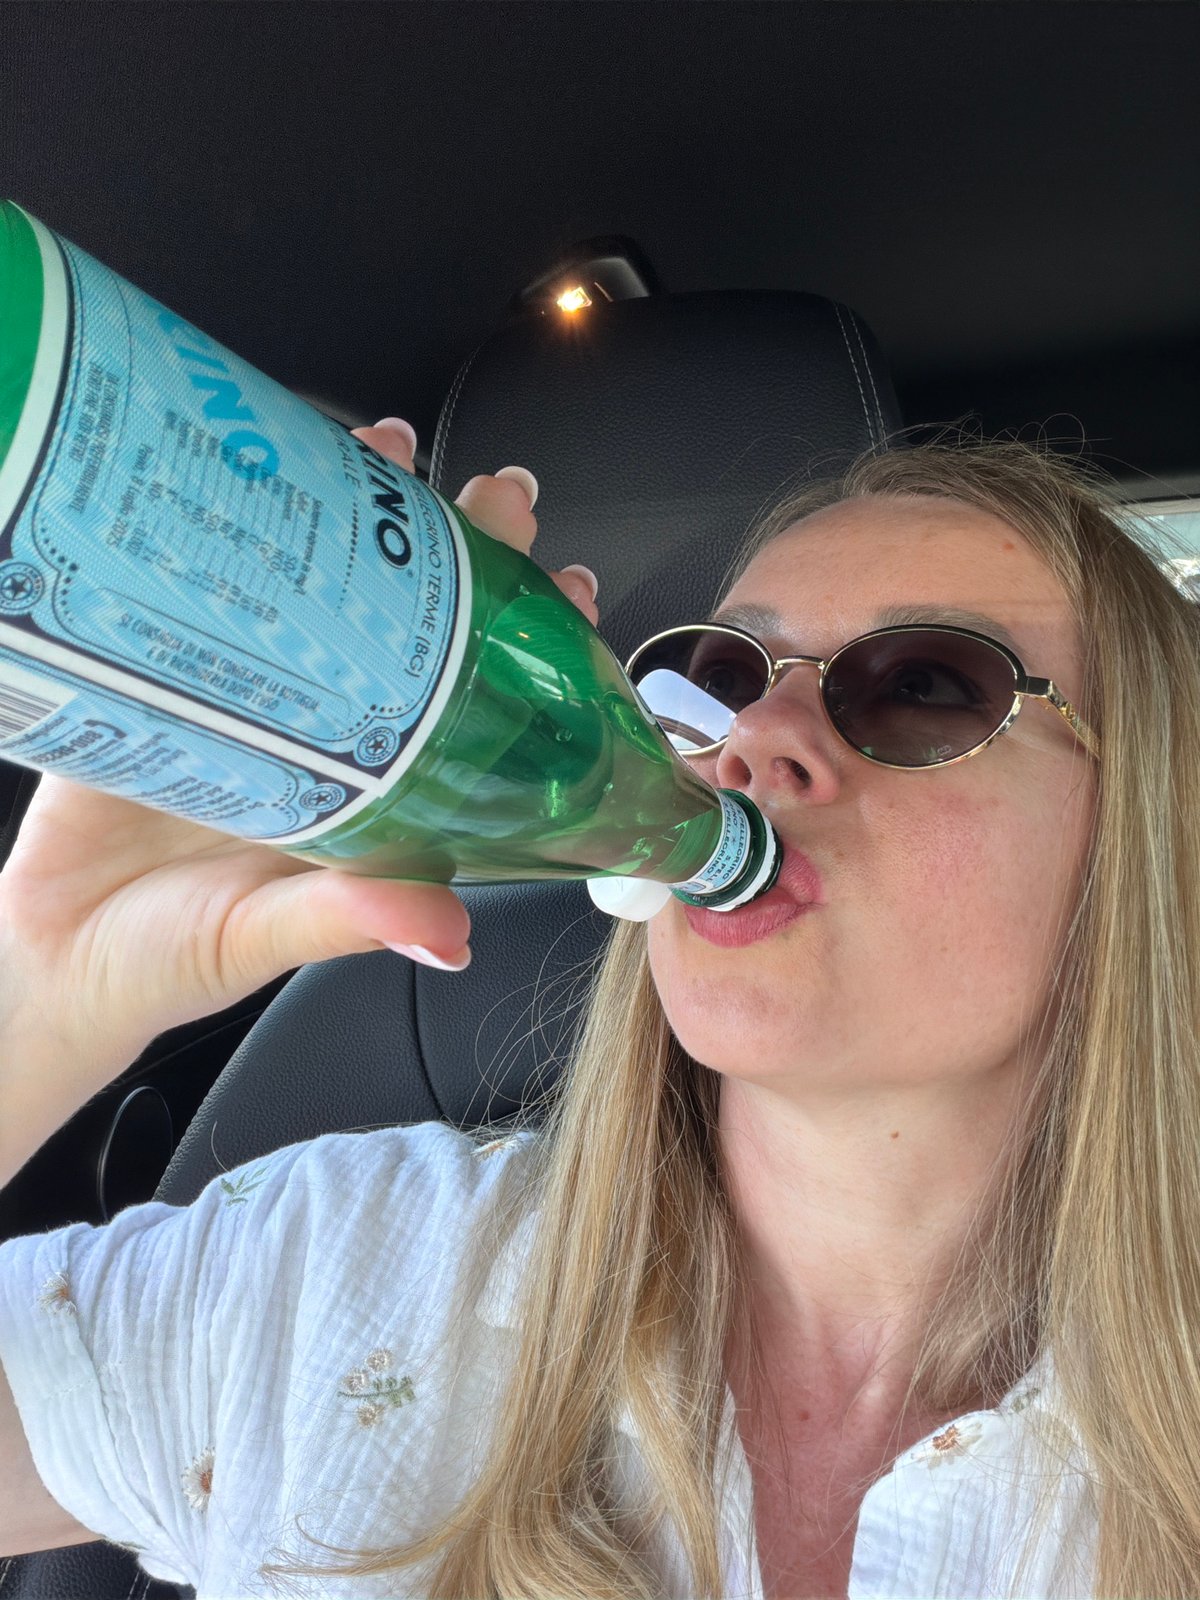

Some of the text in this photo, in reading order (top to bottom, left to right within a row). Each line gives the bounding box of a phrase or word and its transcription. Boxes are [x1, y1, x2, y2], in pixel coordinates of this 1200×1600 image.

[119, 486, 141, 517] Luglio
[105, 517, 127, 548] 2025
[420, 573, 441, 634] TERME
[131, 619, 183, 650] CONSIGLIA
[183, 642, 197, 656] DI
[196, 647, 218, 666] NON
[217, 657, 268, 685] CONGELARE
[266, 680, 280, 693] LA
[279, 685, 320, 712] BOTTIGLIA
[404, 636, 431, 678] (BG)
[226, 680, 255, 700] DOPO
